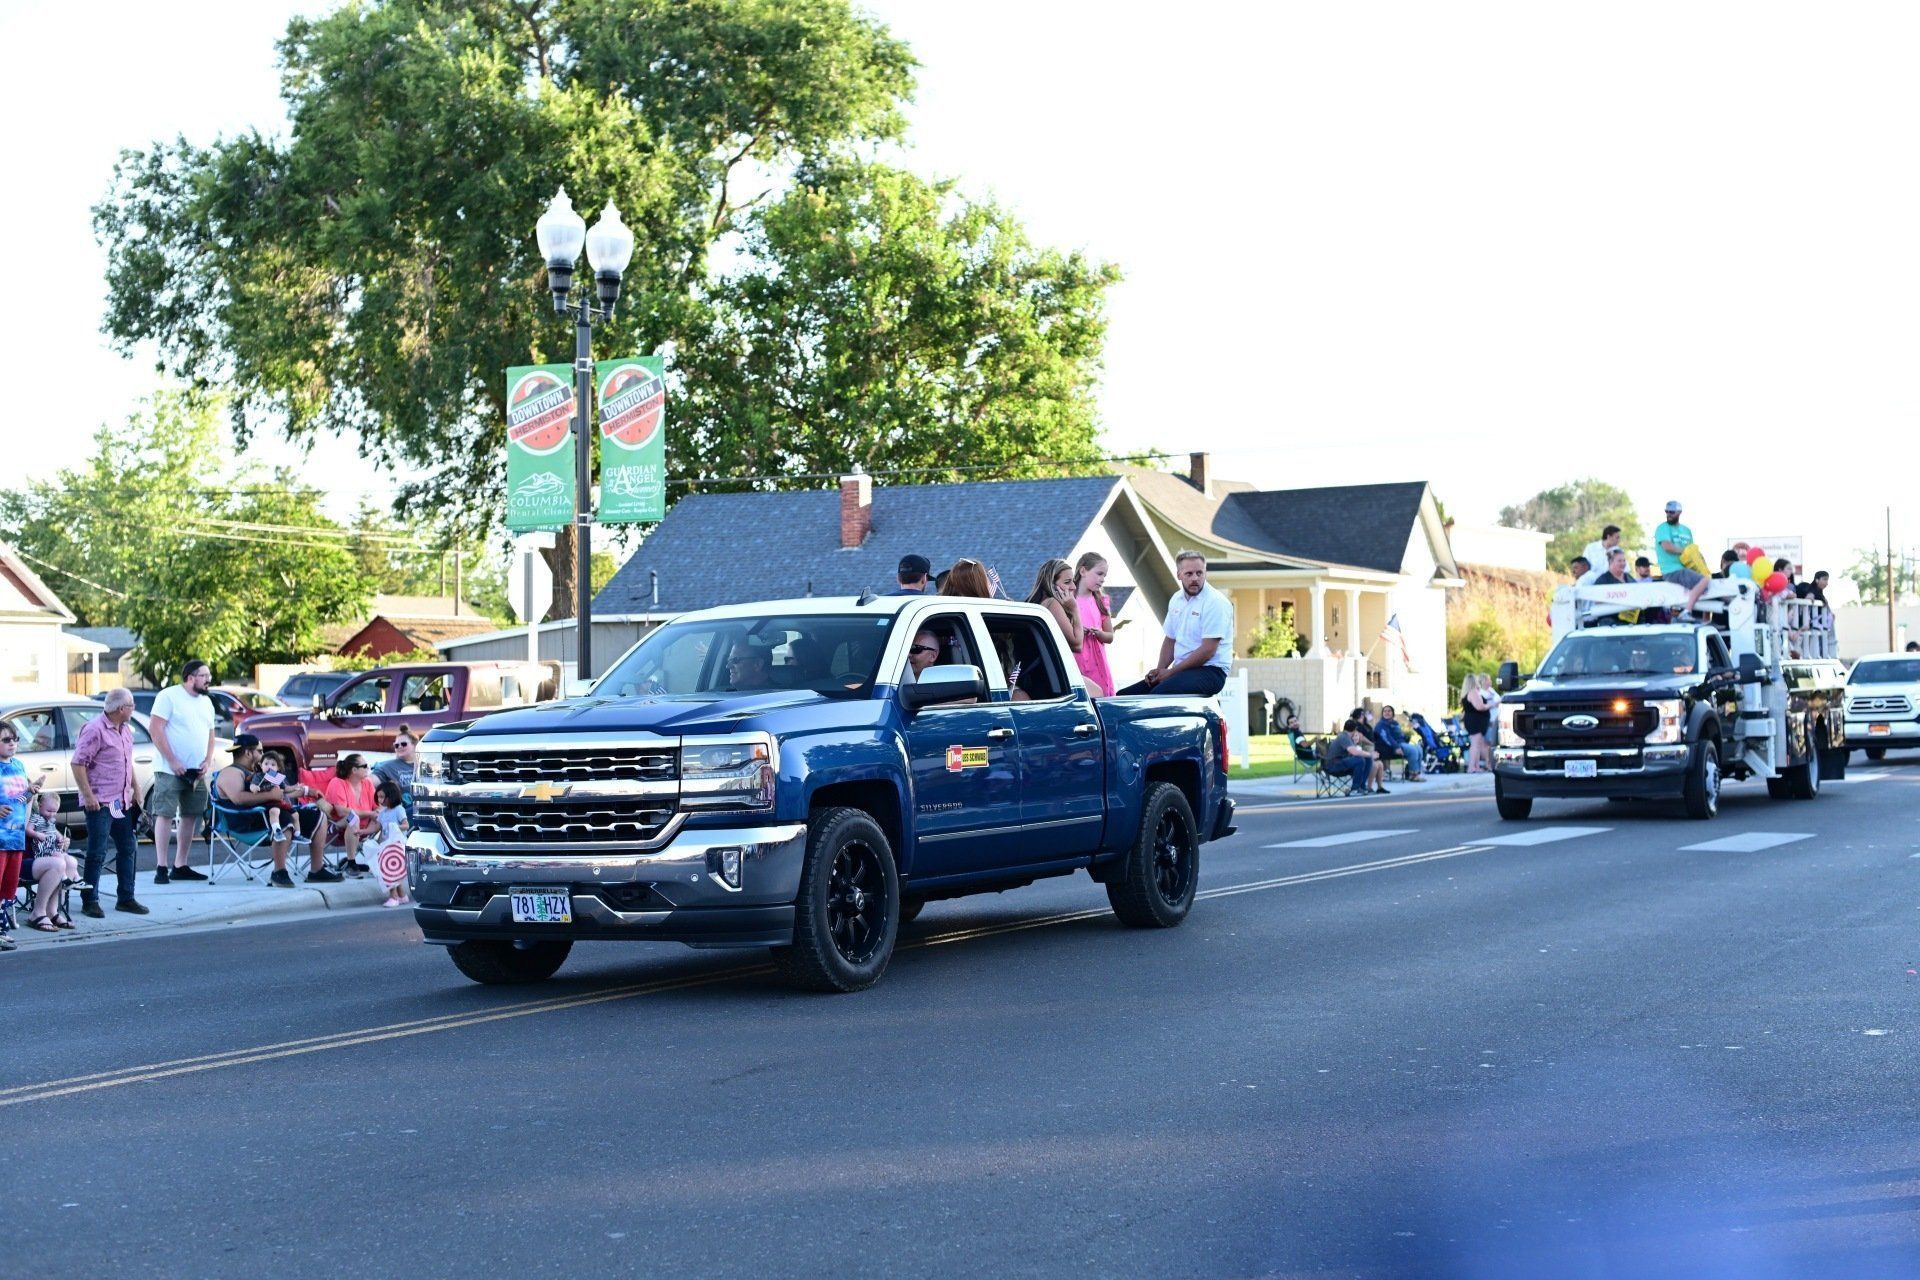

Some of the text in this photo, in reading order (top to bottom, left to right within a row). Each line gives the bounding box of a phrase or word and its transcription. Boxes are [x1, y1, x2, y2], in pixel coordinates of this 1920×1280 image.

[511, 390, 565, 425] DOWNTOWN
[604, 382, 655, 420] DOWNTOWN
[608, 397, 660, 432] HERMISTON
[514, 404, 570, 437] HERMISTON
[605, 463, 657, 478] GUARDIAN
[510, 495, 572, 507] COLUMBIA
[513, 896, 568, 915] 781 HZX
